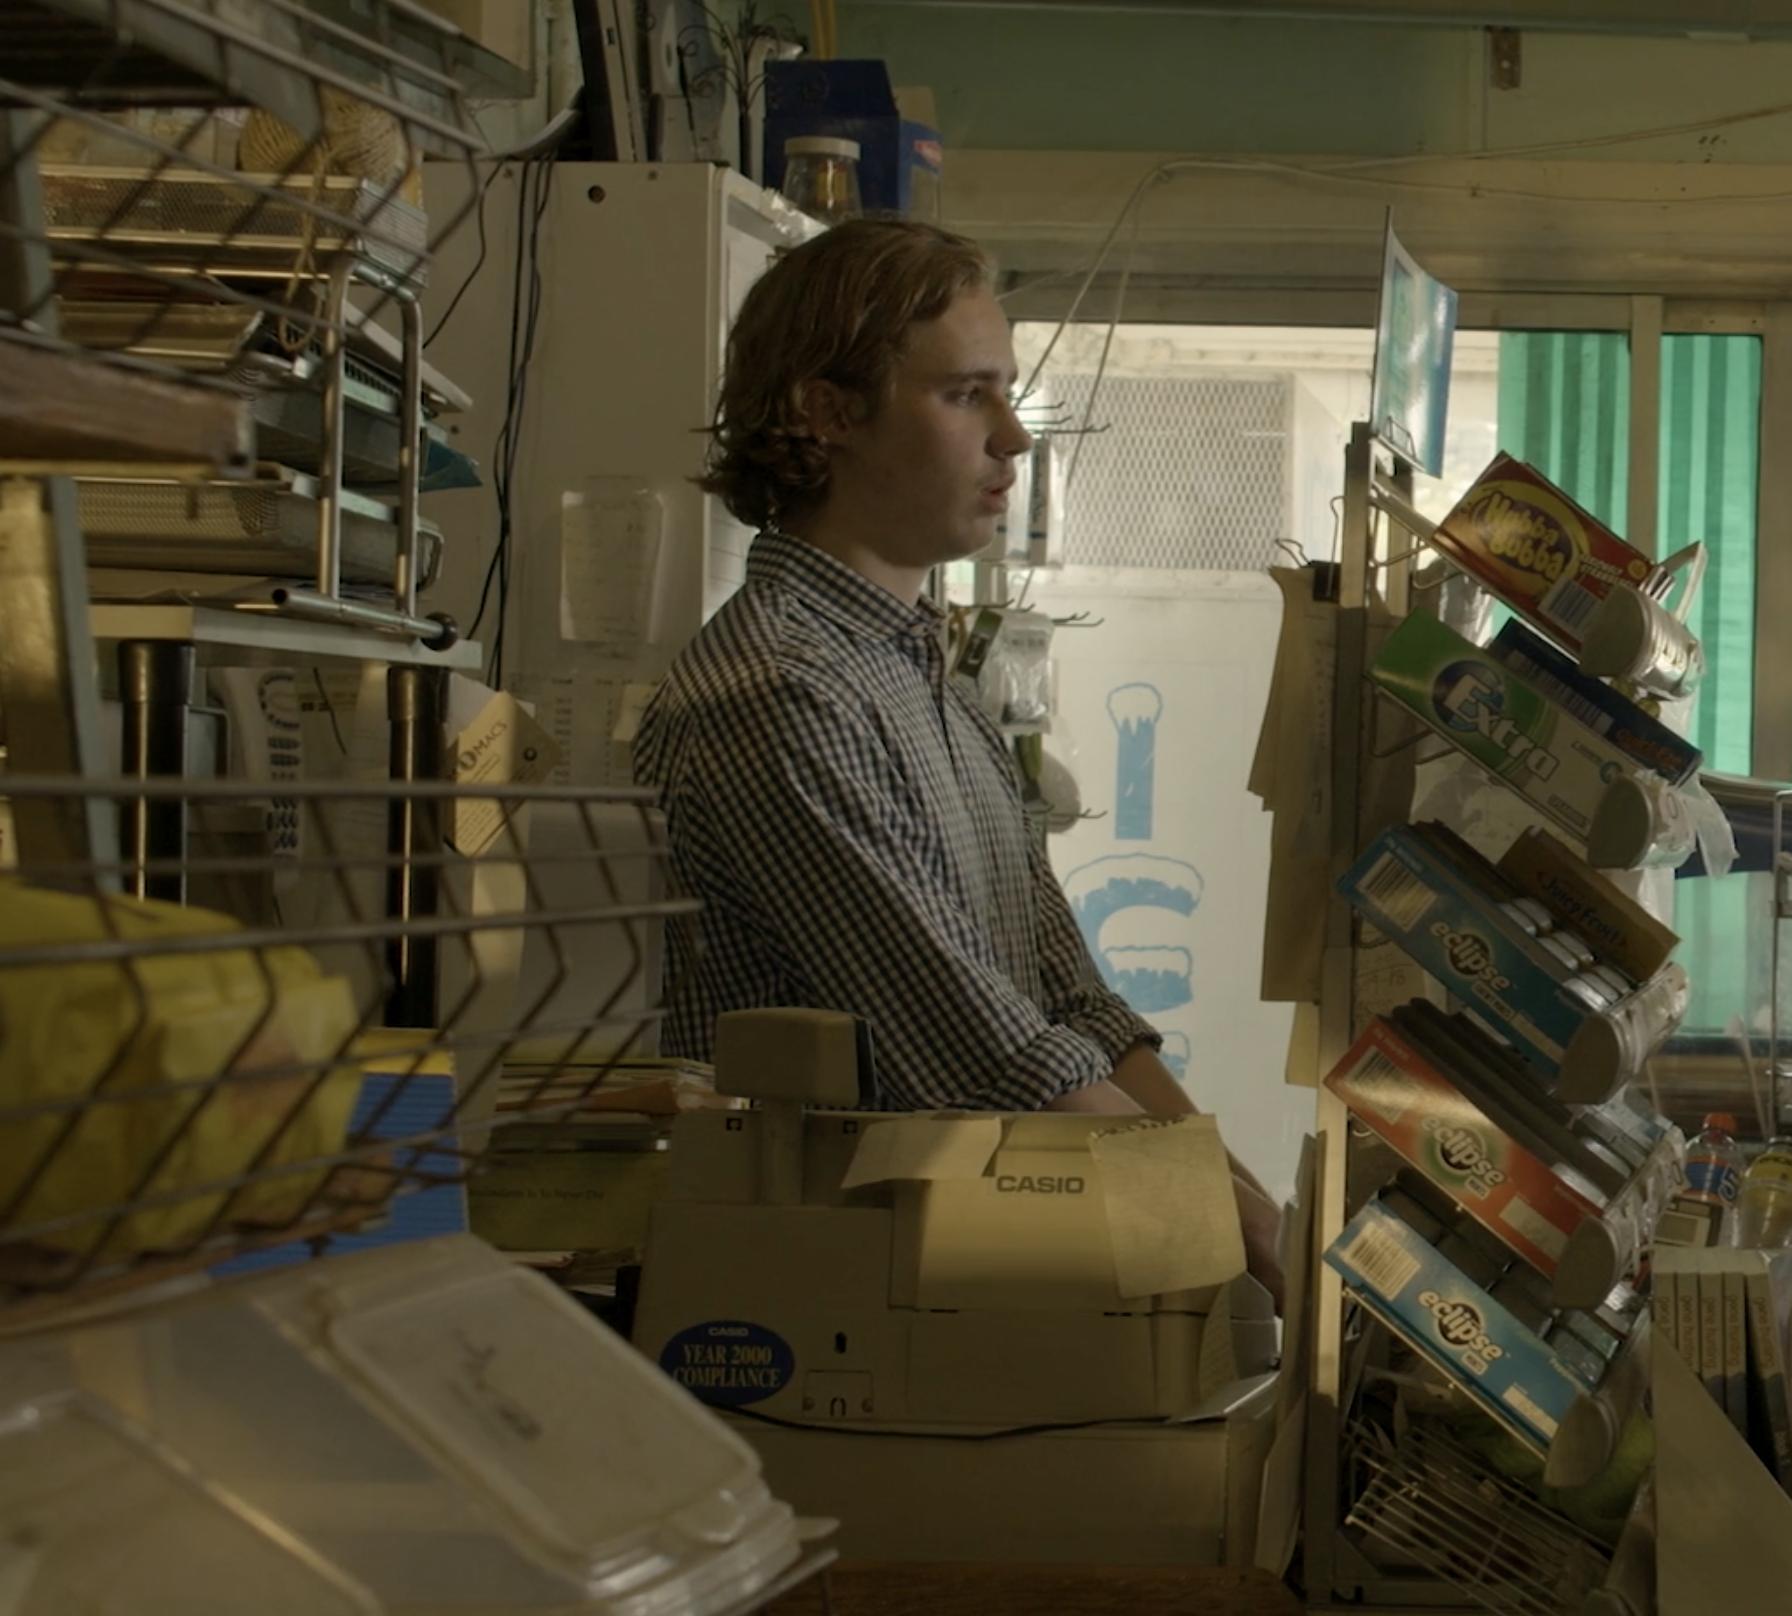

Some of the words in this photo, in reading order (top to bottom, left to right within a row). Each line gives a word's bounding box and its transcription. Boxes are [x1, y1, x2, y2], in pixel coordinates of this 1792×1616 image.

[1444, 673, 1561, 783] Extra
[1430, 920, 1511, 991] eclipse
[1420, 1116, 1506, 1187] eclipse
[996, 1175, 1086, 1195] CASIO
[708, 1326, 749, 1337] CASIO
[1416, 1288, 1505, 1361] eclipse
[673, 1366, 781, 1387] COMPLIANCE
[683, 1343, 727, 1364] YEAR
[731, 1344, 773, 1365] 2000
